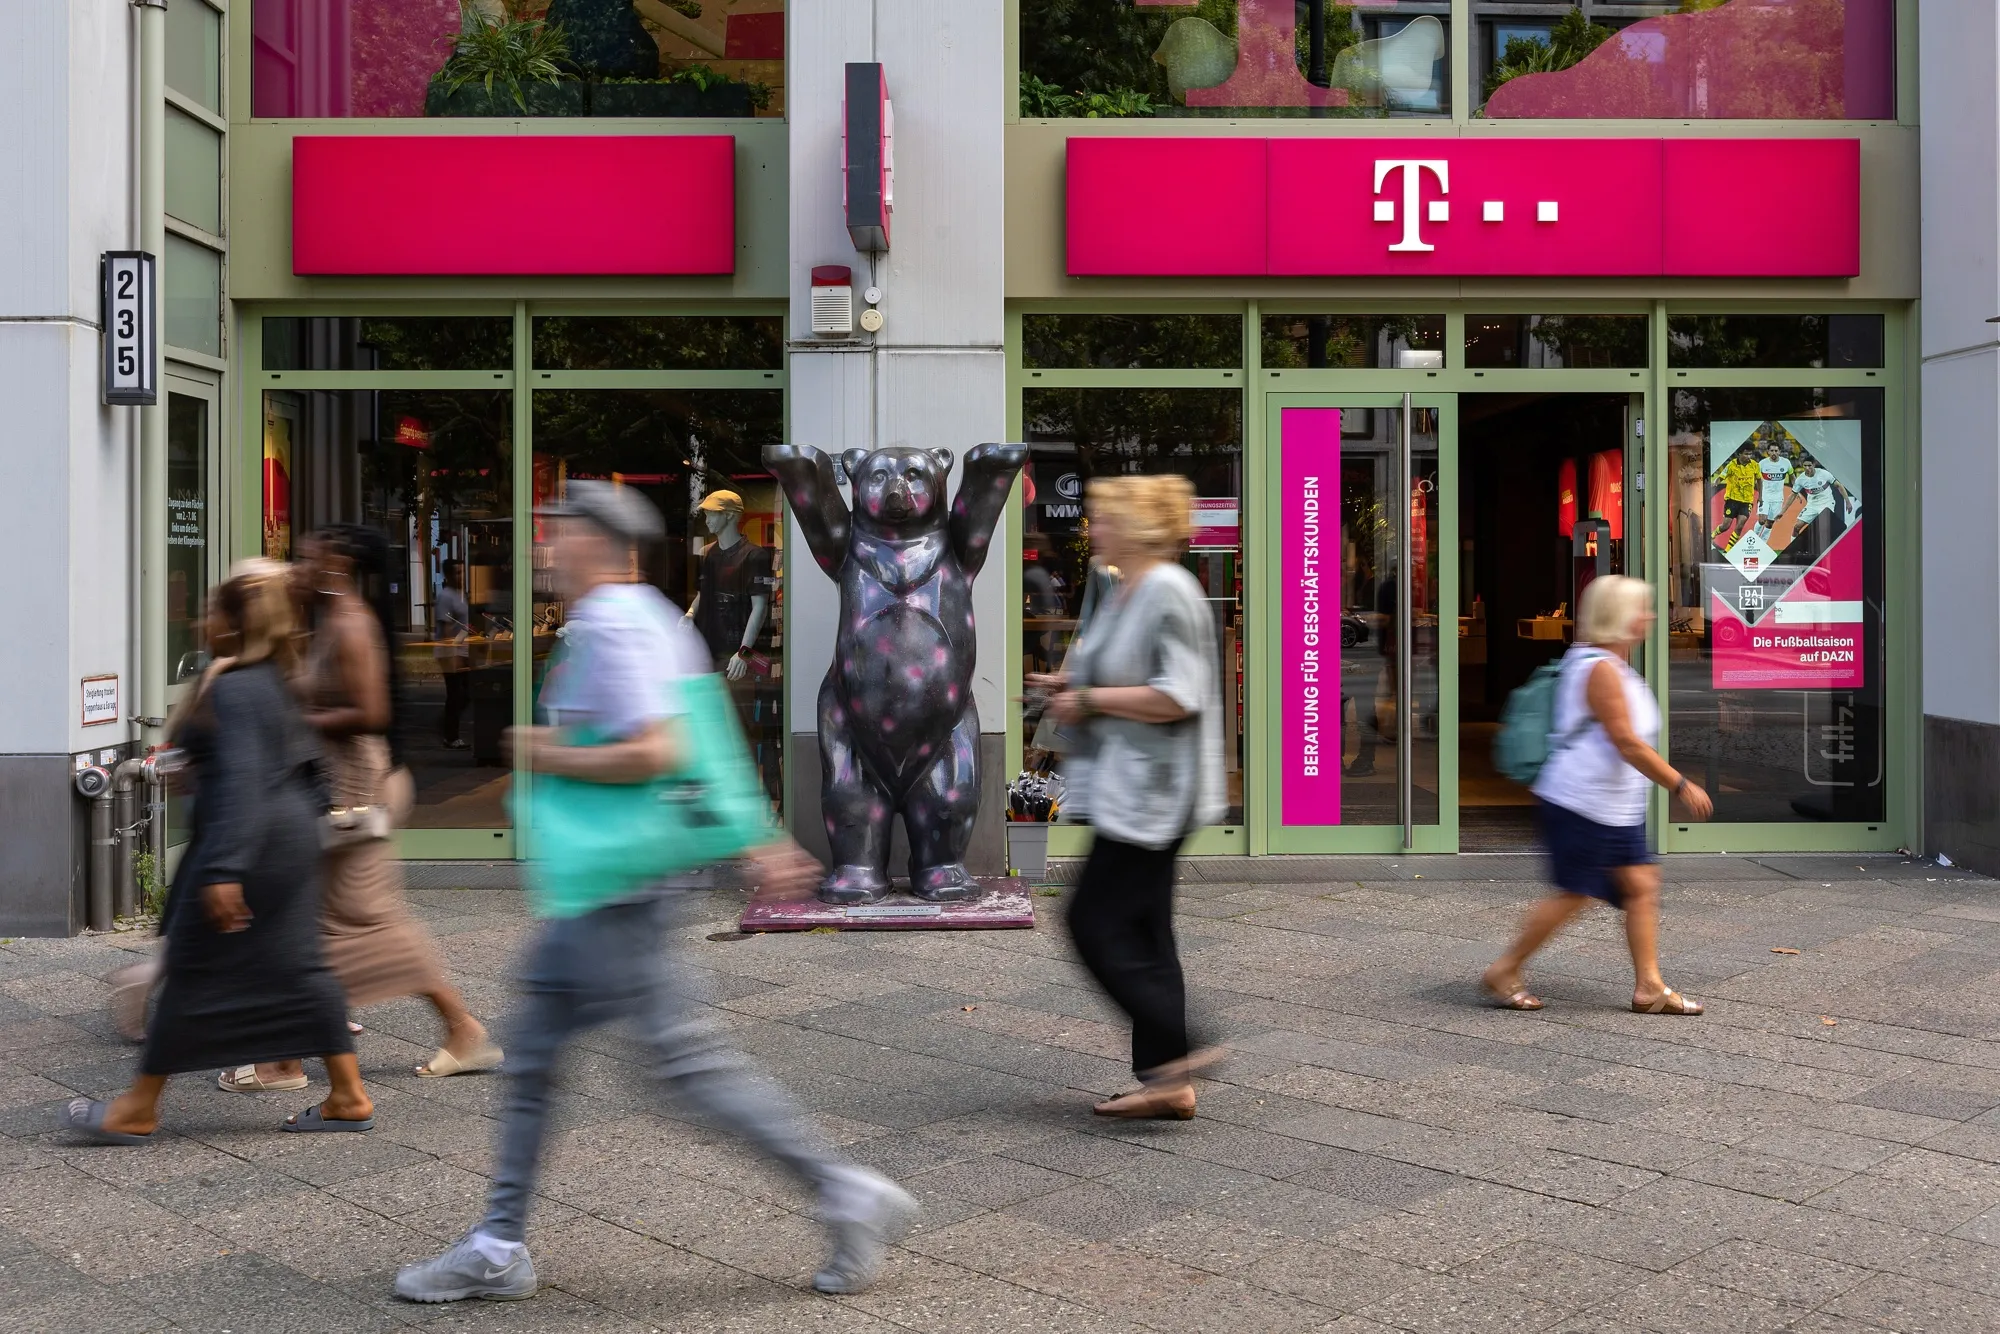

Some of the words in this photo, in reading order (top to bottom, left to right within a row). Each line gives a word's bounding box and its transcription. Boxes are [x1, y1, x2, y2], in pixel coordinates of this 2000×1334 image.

[1301, 476, 1319, 646] GESCHÄFTSKUNDEN
[1753, 637, 1772, 648] Die
[1774, 636, 1854, 648] Fußballsaison
[1800, 651, 1819, 662] auf
[1821, 651, 1854, 662] DAZN
[1301, 649, 1319, 682] FÜR
[1301, 686, 1319, 777] BERATUNG
